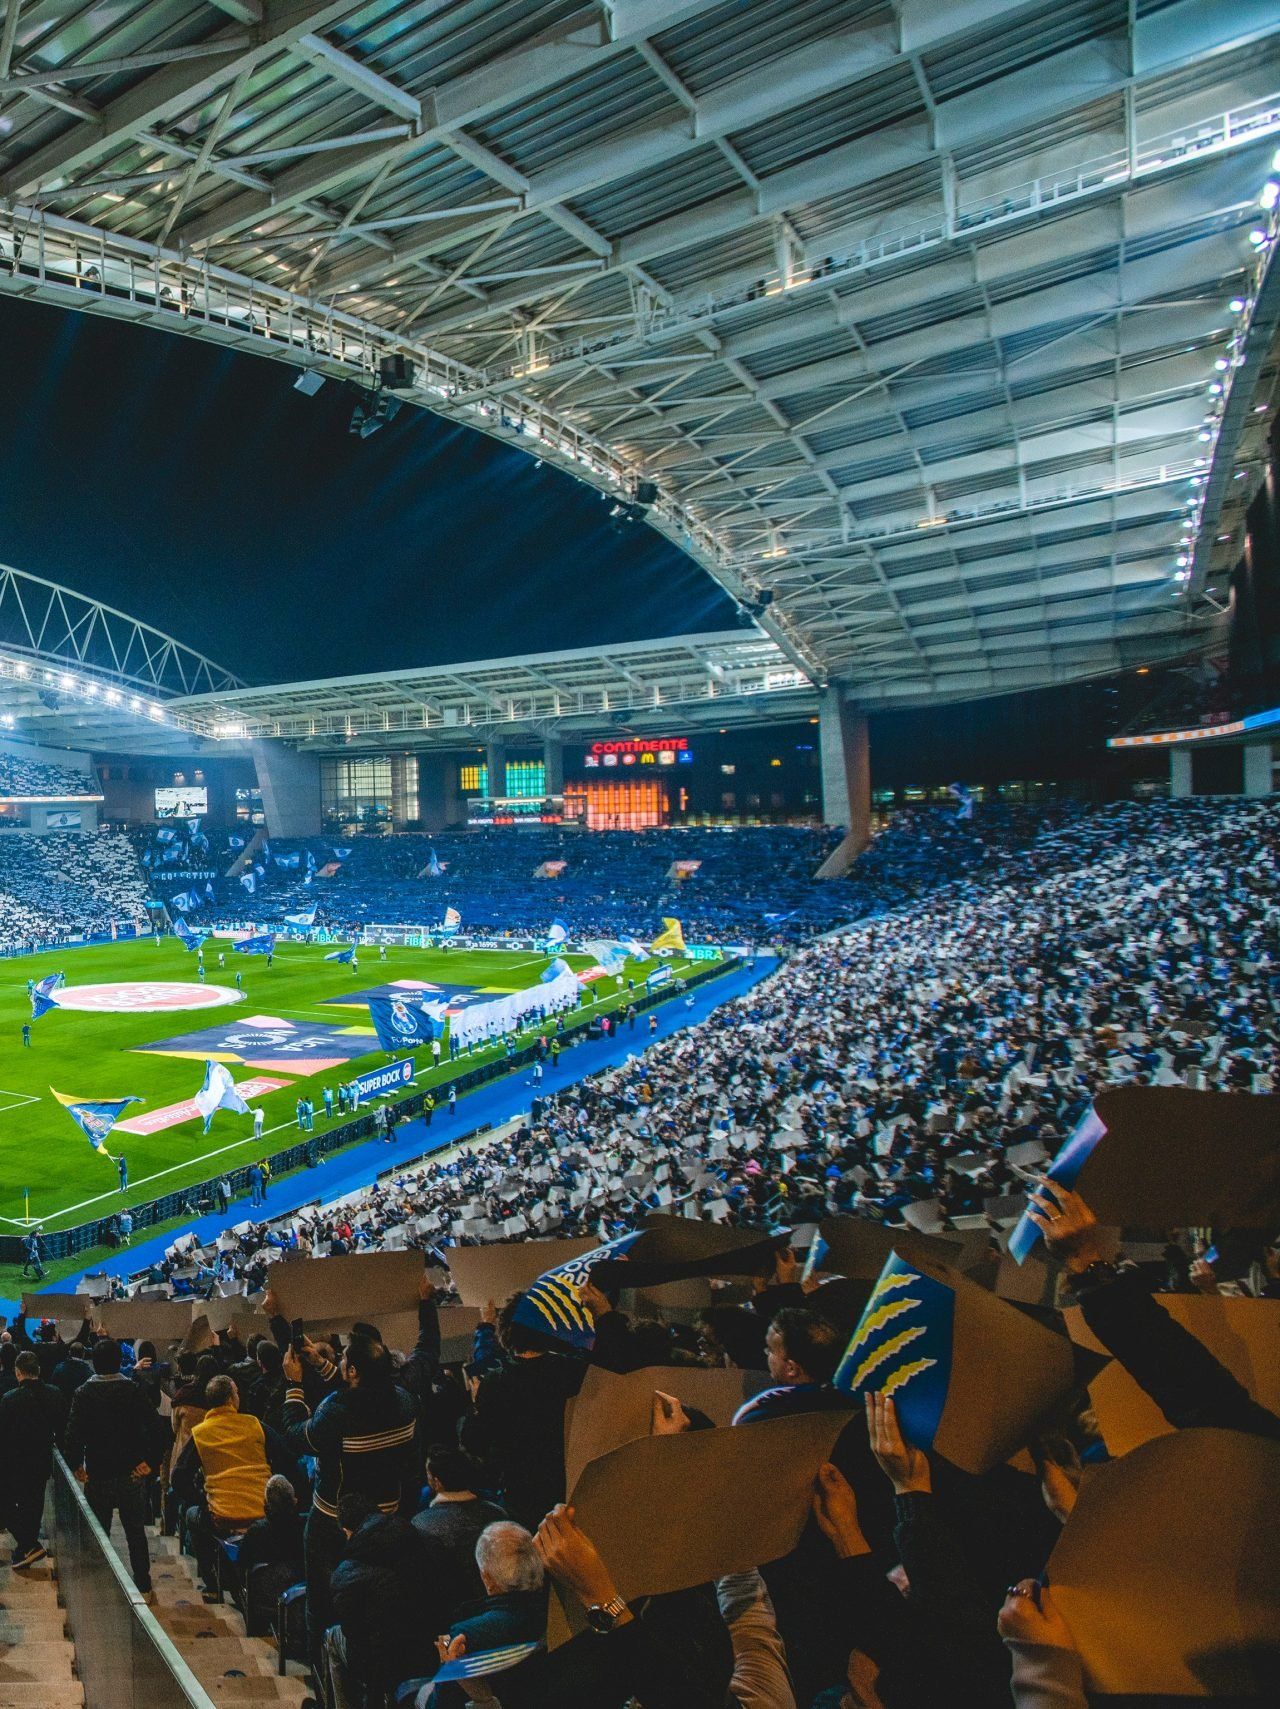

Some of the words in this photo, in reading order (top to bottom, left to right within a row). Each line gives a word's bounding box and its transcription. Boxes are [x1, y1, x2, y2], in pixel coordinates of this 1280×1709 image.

[312, 933, 339, 943] FIBRA
[691, 949, 724, 961] IBRA
[359, 1076, 382, 1096] SUPER
[381, 1068, 401, 1087] BOCK
